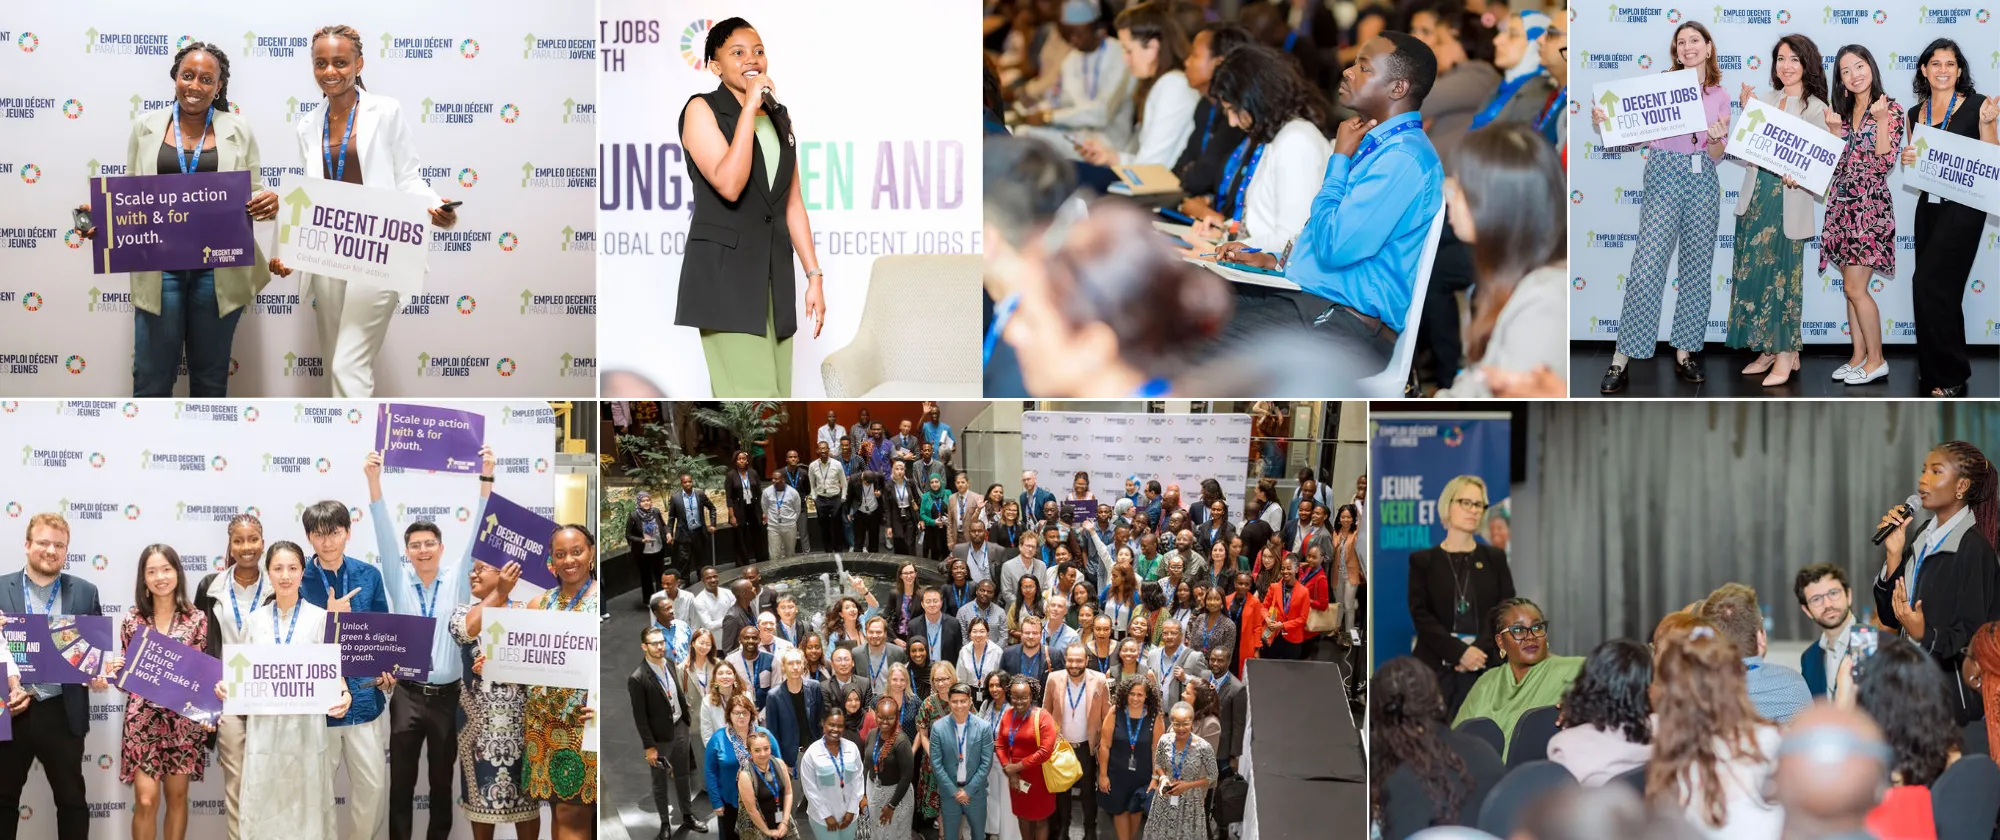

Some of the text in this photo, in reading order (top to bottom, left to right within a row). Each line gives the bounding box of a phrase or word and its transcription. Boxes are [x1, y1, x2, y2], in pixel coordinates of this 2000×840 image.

[1618, 6, 1662, 16] EMPLOI DÉCENT
[1723, 9, 1771, 17] EMPLEO DECENTE
[1832, 9, 1854, 17] DECENT
[1928, 8, 1971, 17] EMPLOI DÉCENT
[1626, 15, 1648, 23] JEUNES
[1840, 17, 1859, 25] YOUTH
[613, 20, 660, 44] JOBS
[100, 34, 169, 45] EMPLEO DECENTE
[257, 36, 308, 47] DECENT JOBS
[394, 35, 453, 48] EMPLOI DÉCENT
[537, 39, 596, 49] EMPLEO DECENT
[134, 44, 169, 56] JÓVENES
[268, 47, 294, 57] YOUTH
[404, 48, 433, 59] JEUNES
[1590, 52, 1633, 62] EMPLOI DÉCENT
[1598, 61, 1619, 69] JEUNES
[24, 95, 55, 108] DÉCENT
[1622, 86, 1698, 113] DECENT JOBS
[435, 101, 493, 113] EMPLOI DÉCENT
[5, 108, 34, 119] JEUNES
[445, 113, 473, 124] JEUNES
[1616, 106, 1682, 131] FOR YOUTH
[1762, 123, 1836, 167] DECENT JOBS
[1748, 132, 1812, 171] FOR YOUTH
[1928, 148, 2000, 180] EMPLOI DÉCEN
[422, 165, 451, 178] DÉCENT
[535, 167, 564, 177] EMPLEO
[1920, 160, 1938, 175] DES
[1938, 166, 1975, 188] JEUNES
[600, 143, 695, 221] UNG,
[871, 140, 964, 210] AND
[115, 188, 227, 206] Scale up action
[116, 209, 190, 225] with & for
[312, 205, 424, 246] DECENT JOBS
[26, 226, 57, 238] DÉCENT
[433, 229, 492, 241] EMPLOI DÉCENT
[8, 238, 37, 248] JEUNES
[116, 230, 163, 248] youth.
[600, 231, 655, 255] OBAL
[829, 231, 905, 255] DECENT
[913, 231, 964, 254] JOBS
[298, 227, 389, 265] FOR YOUTH
[443, 241, 472, 252] JEUNES
[256, 294, 285, 304] DECENT
[420, 292, 449, 305] DÉCENT
[533, 295, 563, 305] EMPLEO
[267, 304, 292, 315] YOUTH
[1810, 328, 1828, 336] YOUTH
[28, 351, 58, 364] DÉCENT
[431, 355, 490, 367] EMPLOI DÉCENT
[9, 364, 38, 374] JEUNES
[441, 367, 470, 377] JEUNES
[77, 408, 101, 417] JEUNES
[185, 403, 238, 414] EMPLEO DECENTE
[304, 407, 342, 416] DECENT JOBS
[312, 415, 332, 424] YOUTH
[393, 413, 470, 431] Scale up action
[392, 427, 443, 440] with & for
[390, 439, 423, 453] youth.
[34, 448, 83, 459] EMPLOI DÉCENT
[152, 454, 205, 463] EMPLEO DECENTE
[43, 458, 67, 467] JEUNES
[272, 457, 311, 465] DECENT JOBS
[280, 465, 301, 473] YOUTH
[1379, 476, 1423, 500] JEUNE
[70, 501, 119, 512] EMPLOI DÉCENT
[186, 505, 239, 514] EMPLEO DECENTE
[406, 507, 429, 515] EMPLOI
[79, 511, 103, 520] JEUNES
[1380, 500, 1436, 525] VERT ET
[496, 525, 543, 556] DECENT JOBS
[1380, 524, 1432, 549] DIGITAL
[488, 533, 528, 561] FOR YOUTH
[342, 623, 369, 631] Unlock
[4, 630, 27, 641] YOUNG
[340, 633, 397, 643] green & digital
[507, 632, 551, 648] EMPLOI
[8, 641, 40, 652] REEN AND
[147, 641, 182, 662] It's our
[354, 644, 406, 653] opportunities
[143, 650, 175, 671] future.
[351, 653, 375, 662] youth.
[499, 647, 566, 666] DES JEUNES
[135, 668, 161, 686] work.
[139, 660, 200, 692] Let's make it
[253, 664, 337, 679] DECENT JOBS
[244, 682, 315, 698] FOR YOUTH
